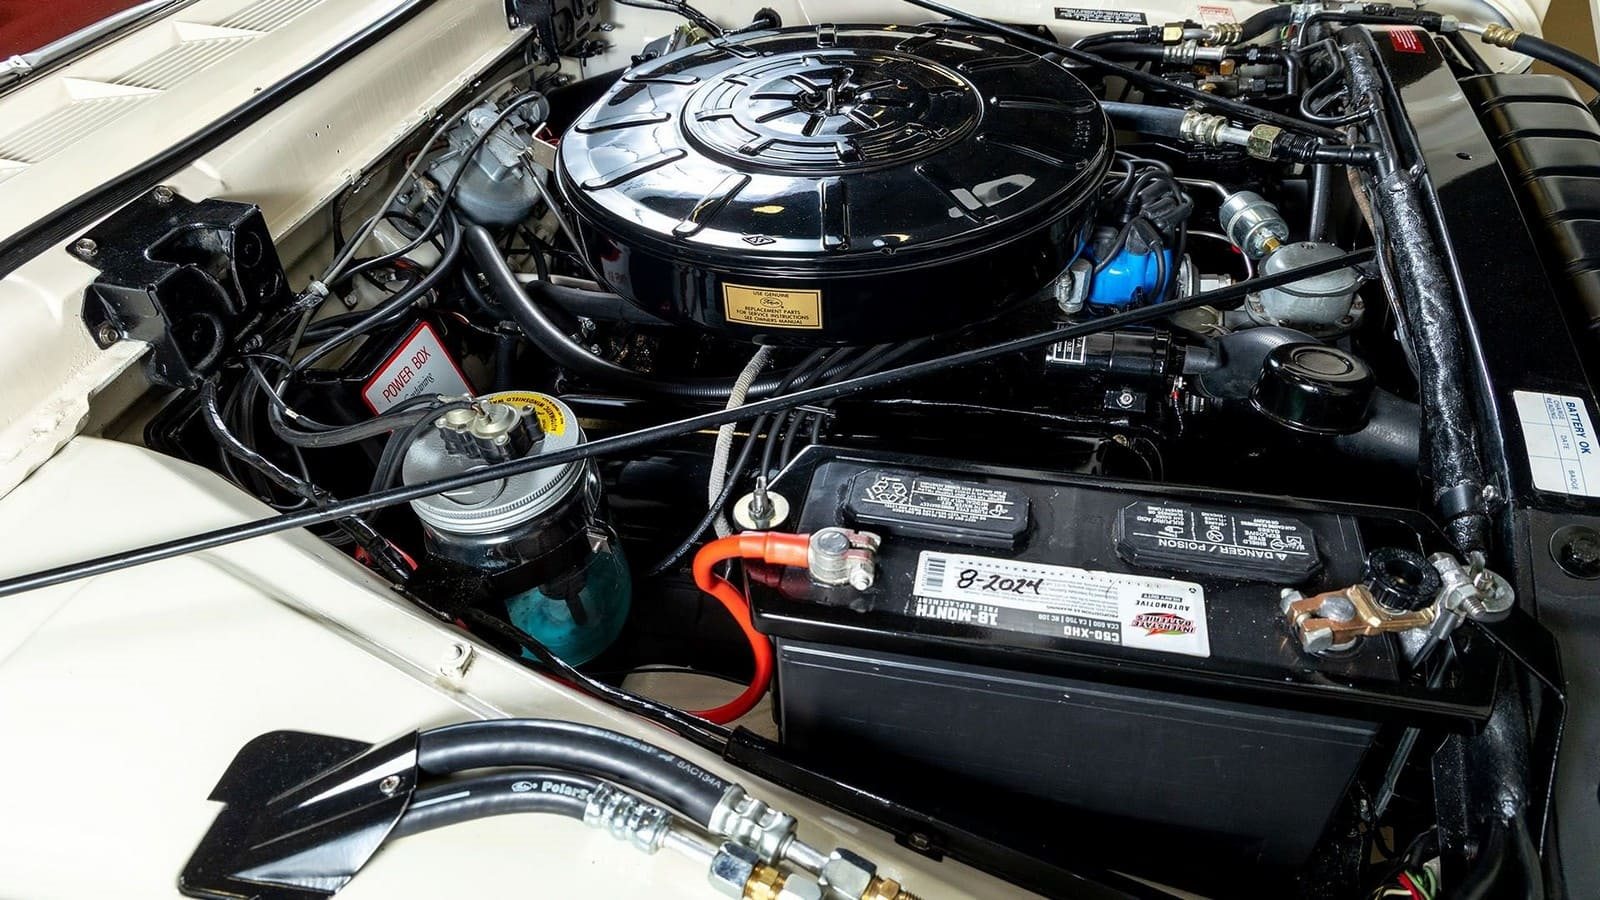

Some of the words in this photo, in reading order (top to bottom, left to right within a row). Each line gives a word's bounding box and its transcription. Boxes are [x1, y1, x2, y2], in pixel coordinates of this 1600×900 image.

[745, 306, 782, 314] REPLACEMENT
[382, 366, 415, 403] POWER
[411, 345, 431, 370] BOX
[1566, 402, 1586, 438] BATTERY
[1579, 441, 1592, 454] OK
[1561, 435, 1570, 449] DATE
[1568, 470, 1579, 490] BADGE
[1158, 539, 1206, 551] POISON
[1220, 546, 1274, 559] DANGER
[957, 569, 1044, 595] 8-2024
[917, 597, 976, 610] REPLACEMENT
[978, 605, 998, 613] FREE
[1136, 600, 1190, 612] AUTOMOTIVE
[916, 604, 998, 626] 18-MONTH
[1136, 615, 1192, 626] BATTERIES
[1064, 626, 1120, 642] C50-XHD
[1130, 622, 1196, 634] INTERSTATE
[677, 760, 721, 789] 8AC134A
